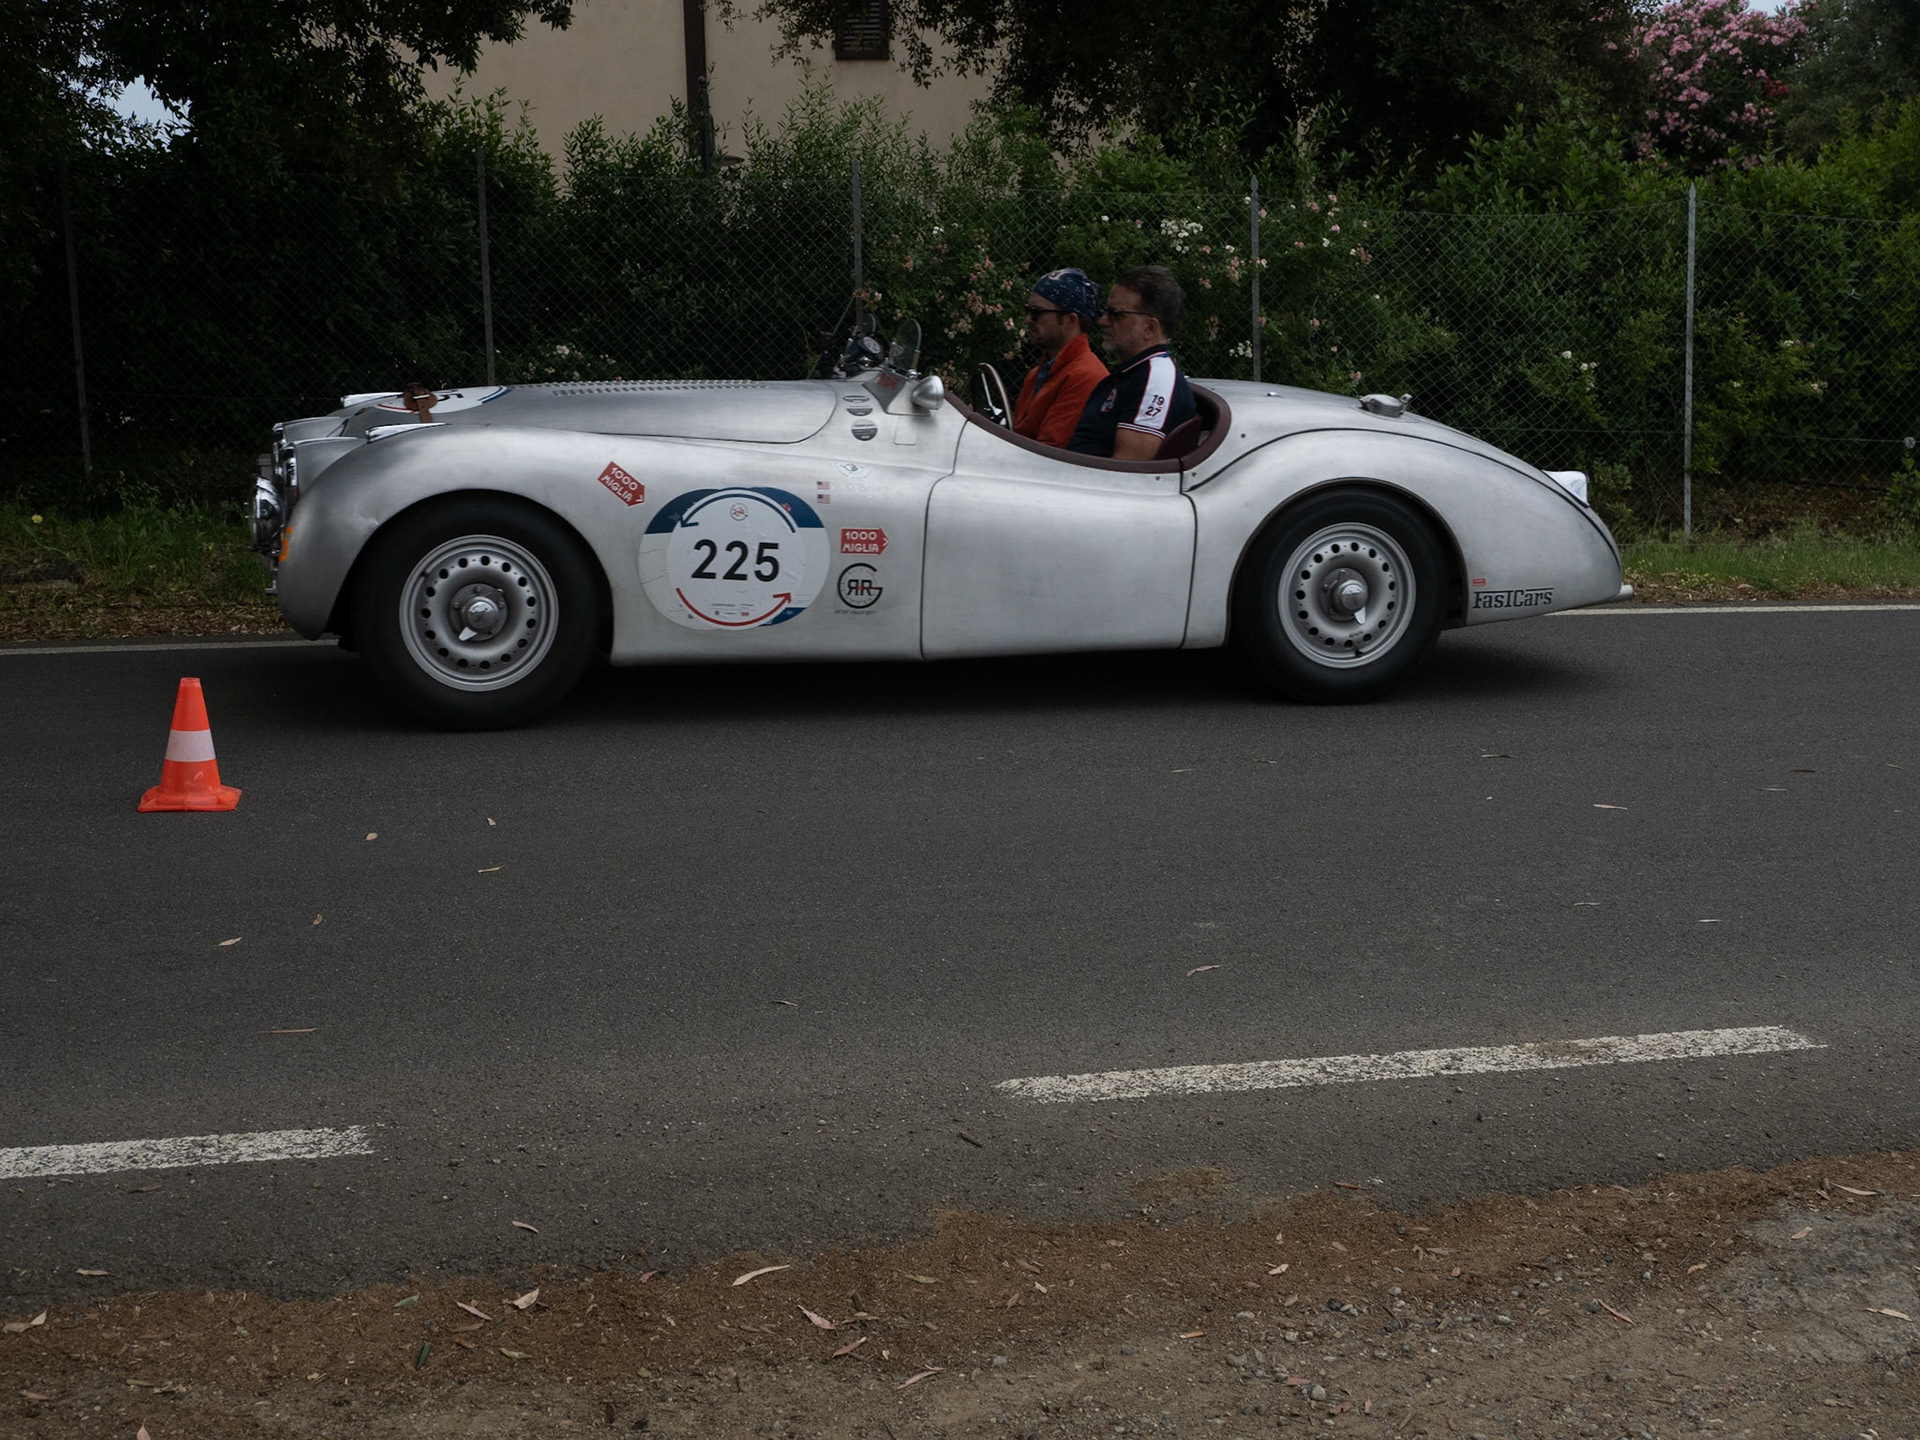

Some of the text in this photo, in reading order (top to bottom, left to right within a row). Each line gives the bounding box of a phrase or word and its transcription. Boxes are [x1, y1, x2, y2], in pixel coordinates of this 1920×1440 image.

[1152, 394, 1164, 405] 19
[1145, 406, 1161, 417] 27
[610, 467, 639, 491] 1000
[600, 474, 633, 502] MIGLIA
[845, 531, 878, 541] 1000
[842, 543, 880, 553] MIGLIA
[690, 538, 780, 582] 225
